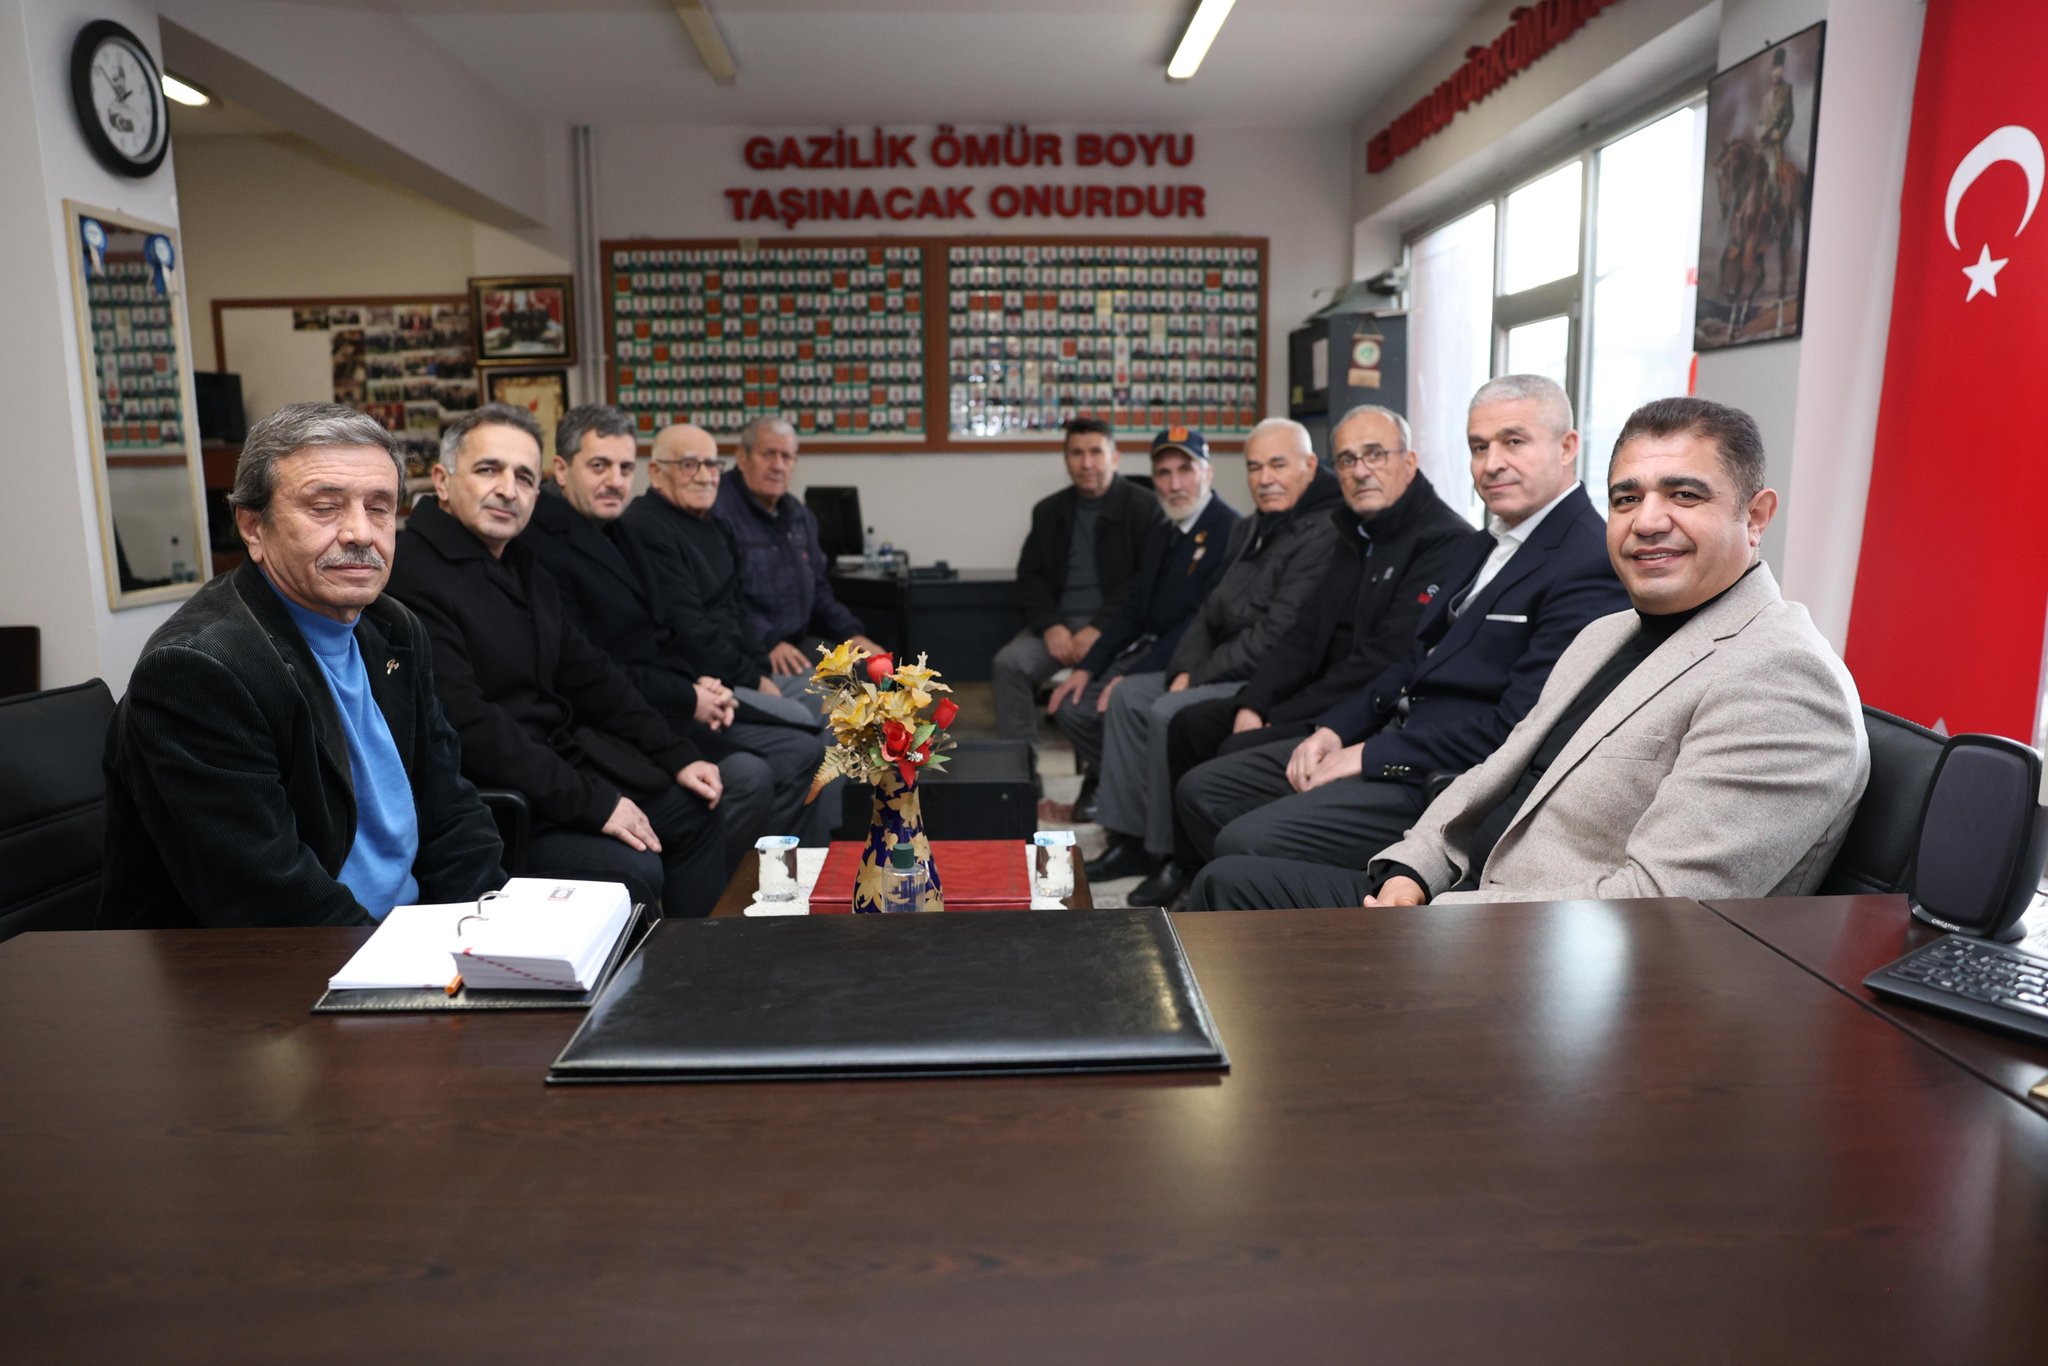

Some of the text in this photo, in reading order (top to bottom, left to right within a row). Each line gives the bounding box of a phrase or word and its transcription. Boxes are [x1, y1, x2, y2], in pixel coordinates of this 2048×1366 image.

[744, 125, 1194, 170] GAZİLİK ÖMÜR BOYU
[724, 185, 1206, 229] TAŞINACAK ONURDUR
[1931, 918, 1960, 931] CREATIVE
